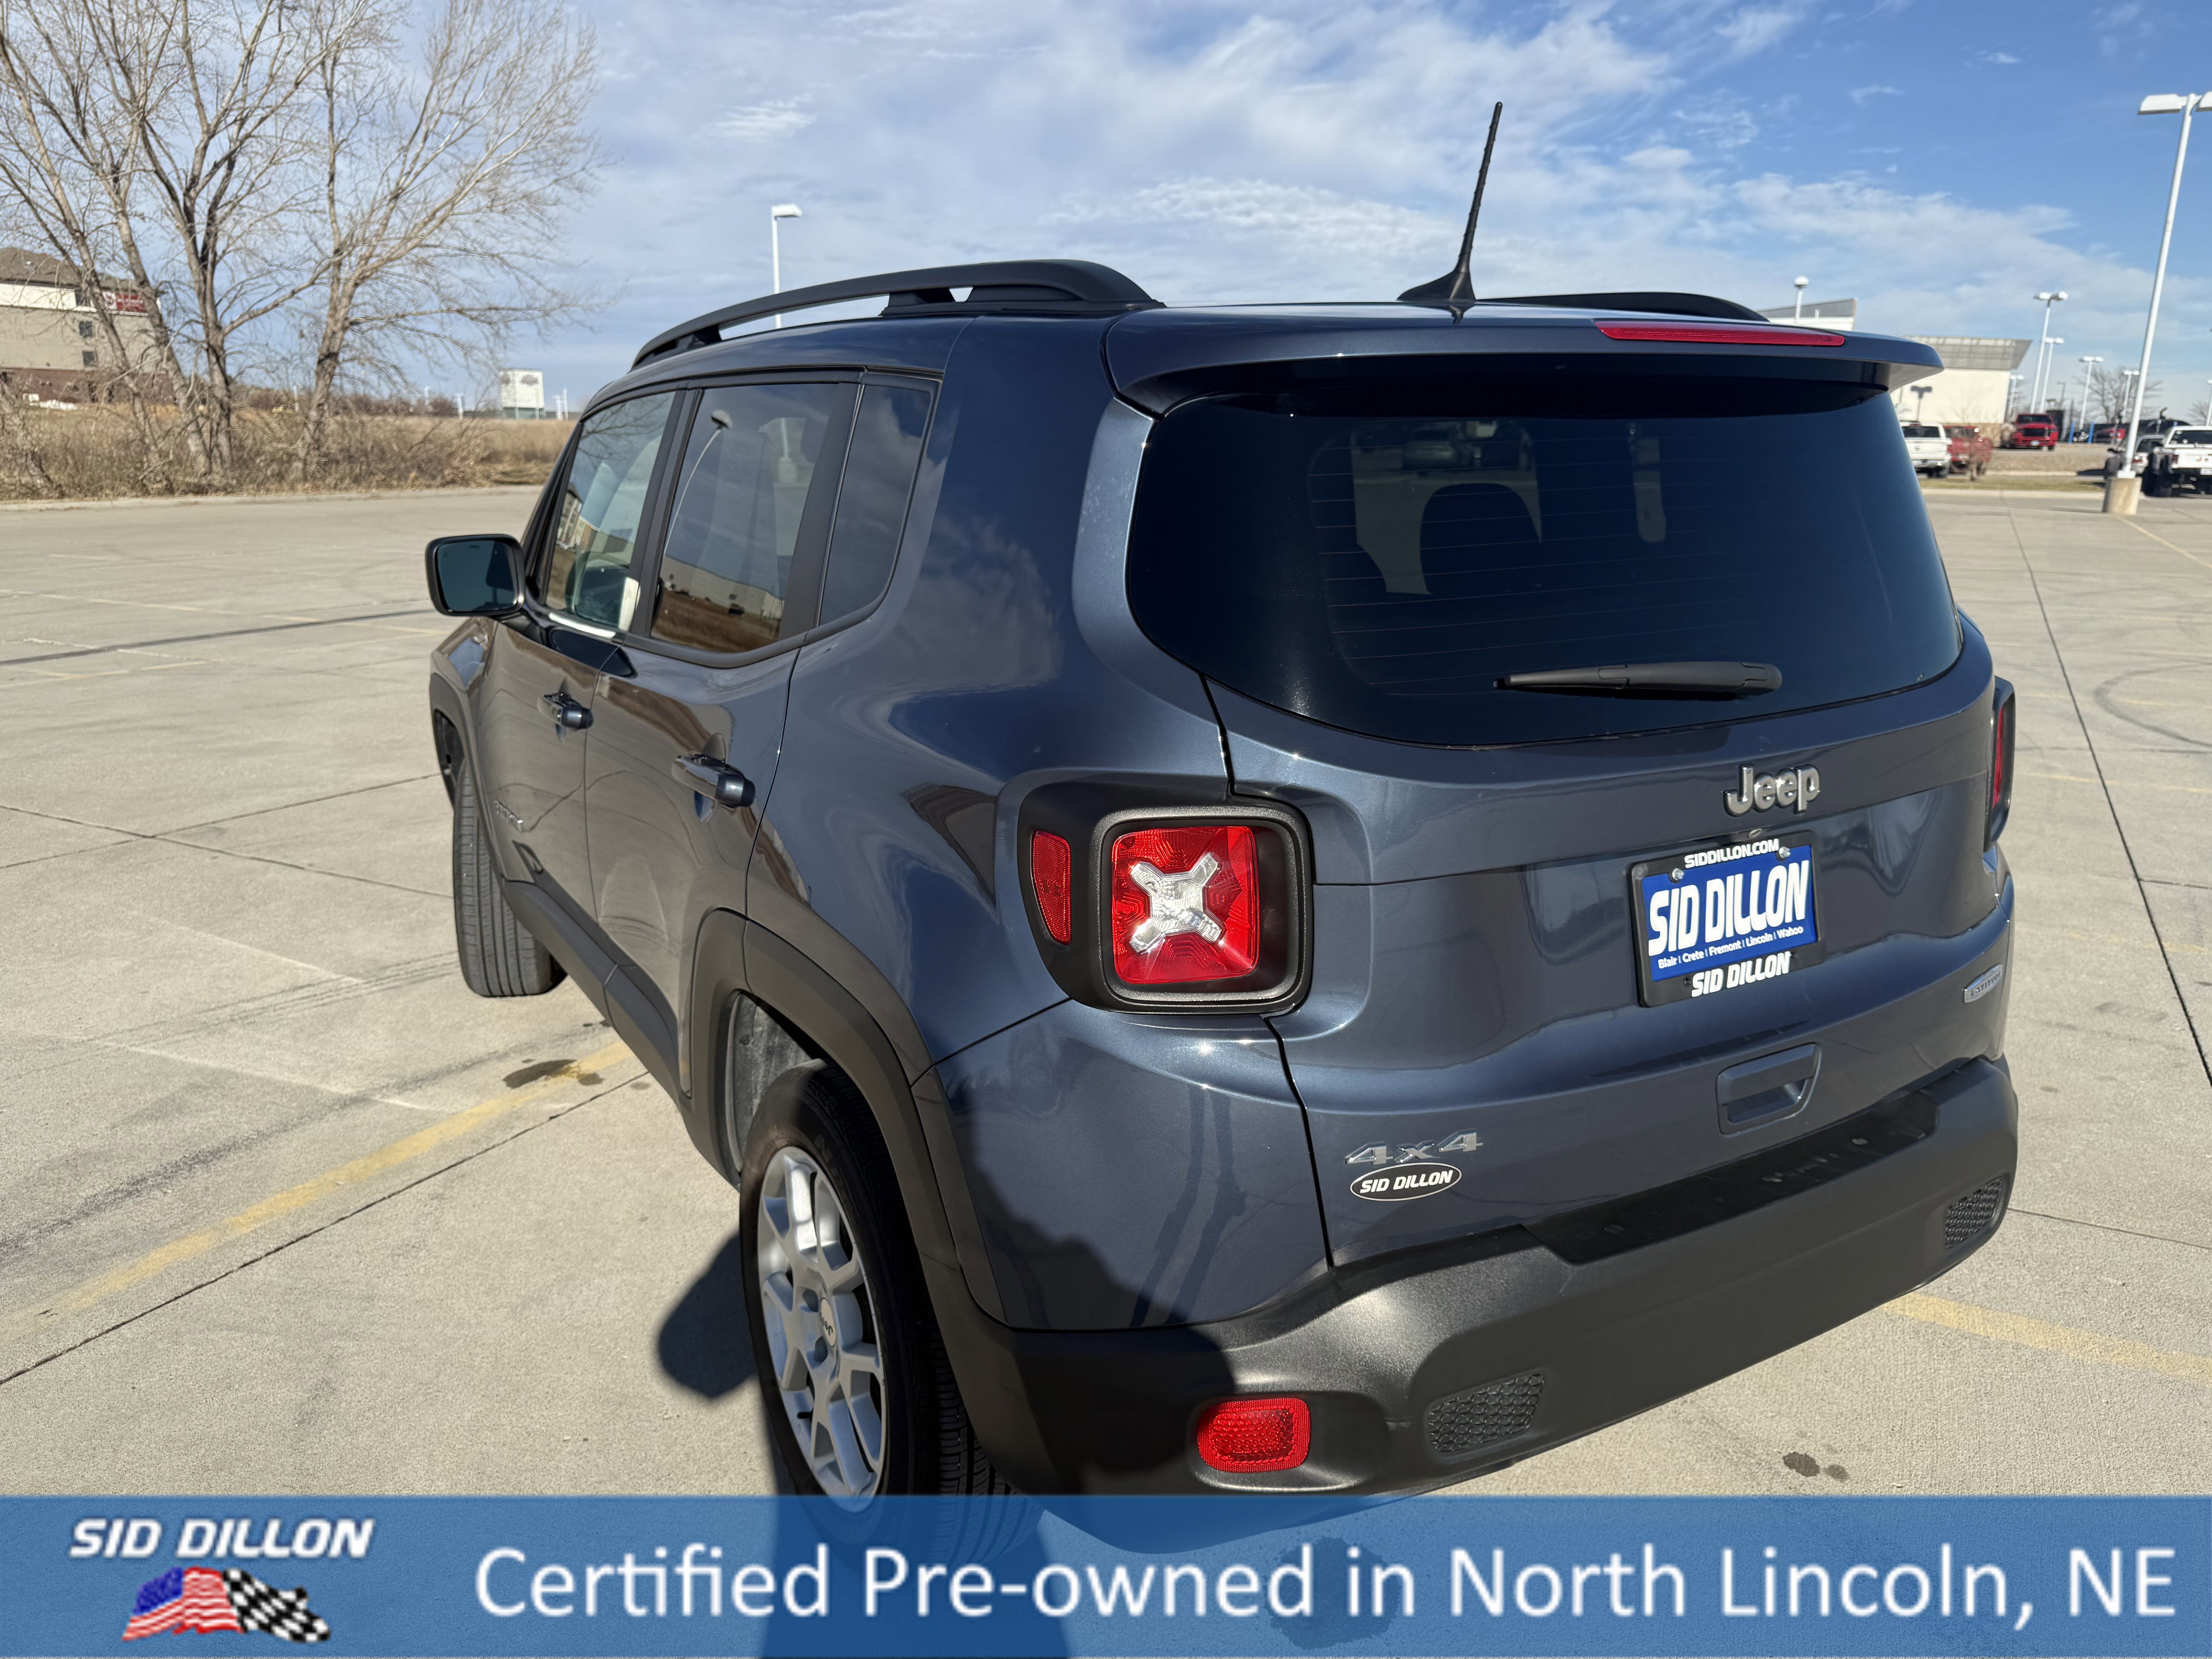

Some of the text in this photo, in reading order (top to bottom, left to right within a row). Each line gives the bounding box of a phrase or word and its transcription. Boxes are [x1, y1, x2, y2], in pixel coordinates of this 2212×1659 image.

[1723, 764, 1819, 817] Jeep
[1684, 838, 1779, 868] SIDDILLON.COM
[1648, 860, 1810, 956] SID DILLON
[1658, 926, 1803, 969] Blair Crete Fremont Lincoln Wahoo
[1692, 951, 1791, 997] SID DILLON
[1360, 1170, 1453, 1193] SID DILLON
